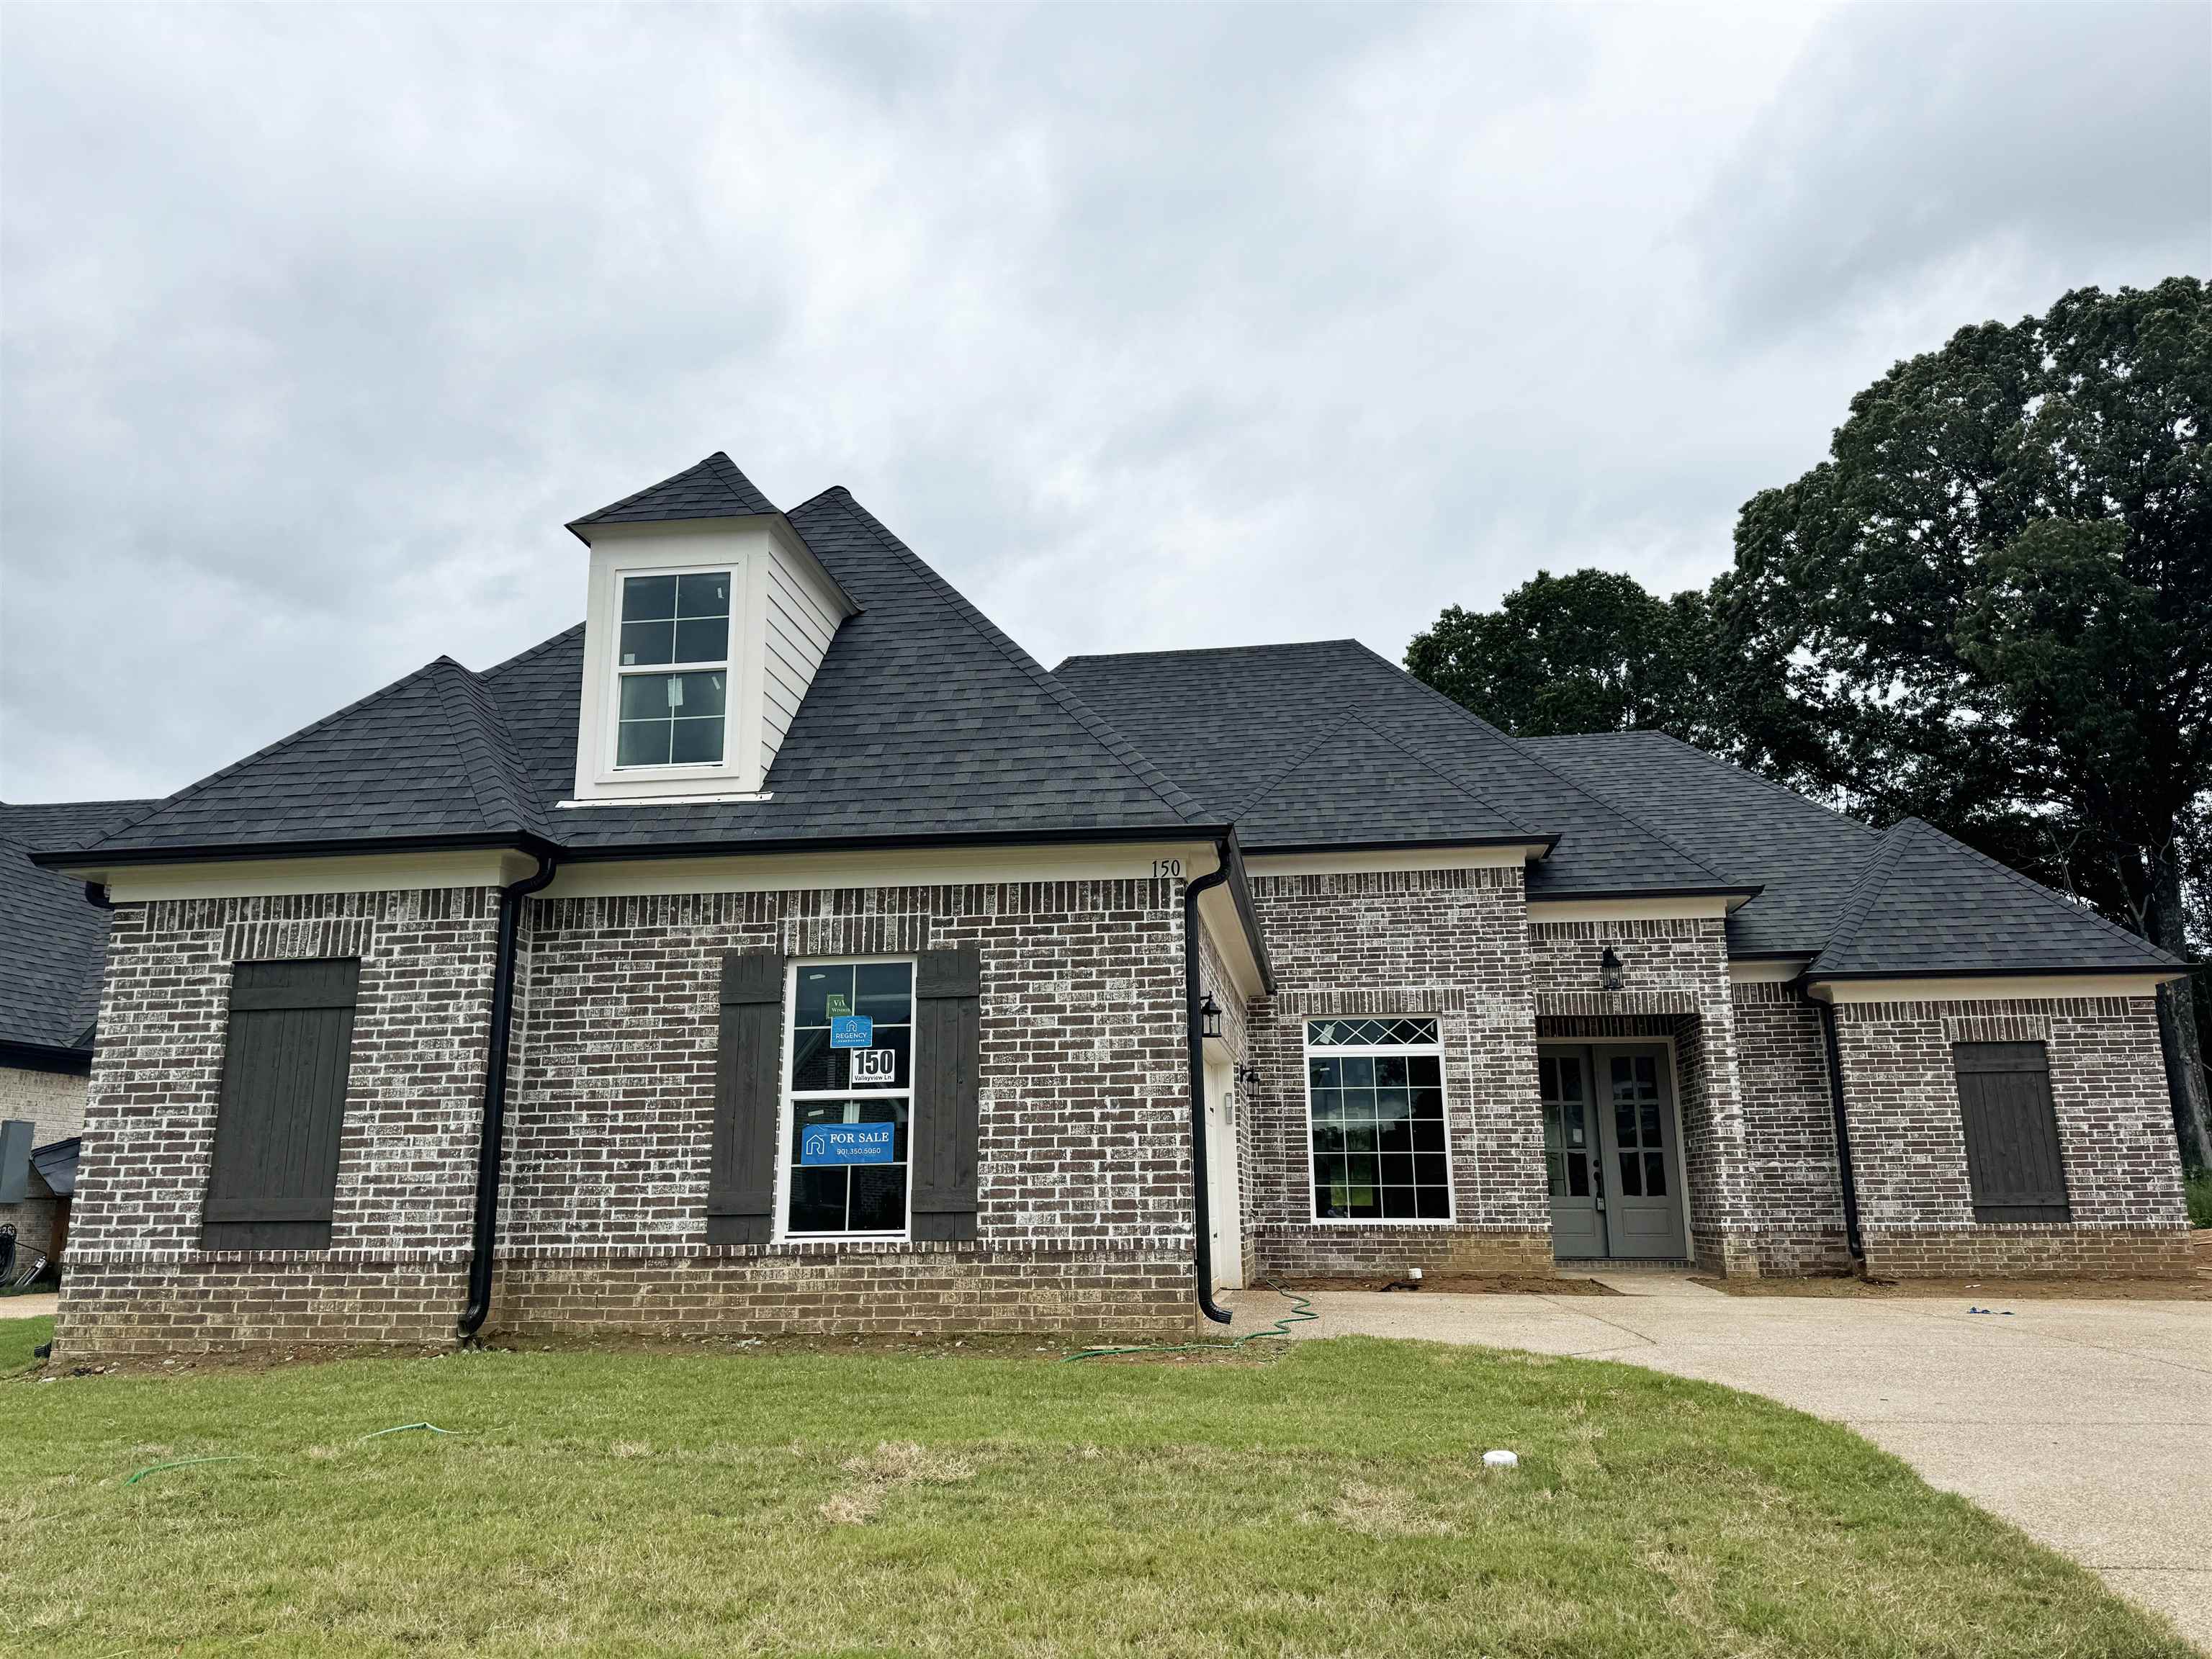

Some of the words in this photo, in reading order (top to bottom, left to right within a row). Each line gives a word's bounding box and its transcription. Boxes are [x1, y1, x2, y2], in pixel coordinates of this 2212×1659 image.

[1152, 860, 1180, 877] 150
[855, 1051, 894, 1074] 150
[830, 1133, 855, 1143] FOR
[859, 1132, 889, 1143] SALE
